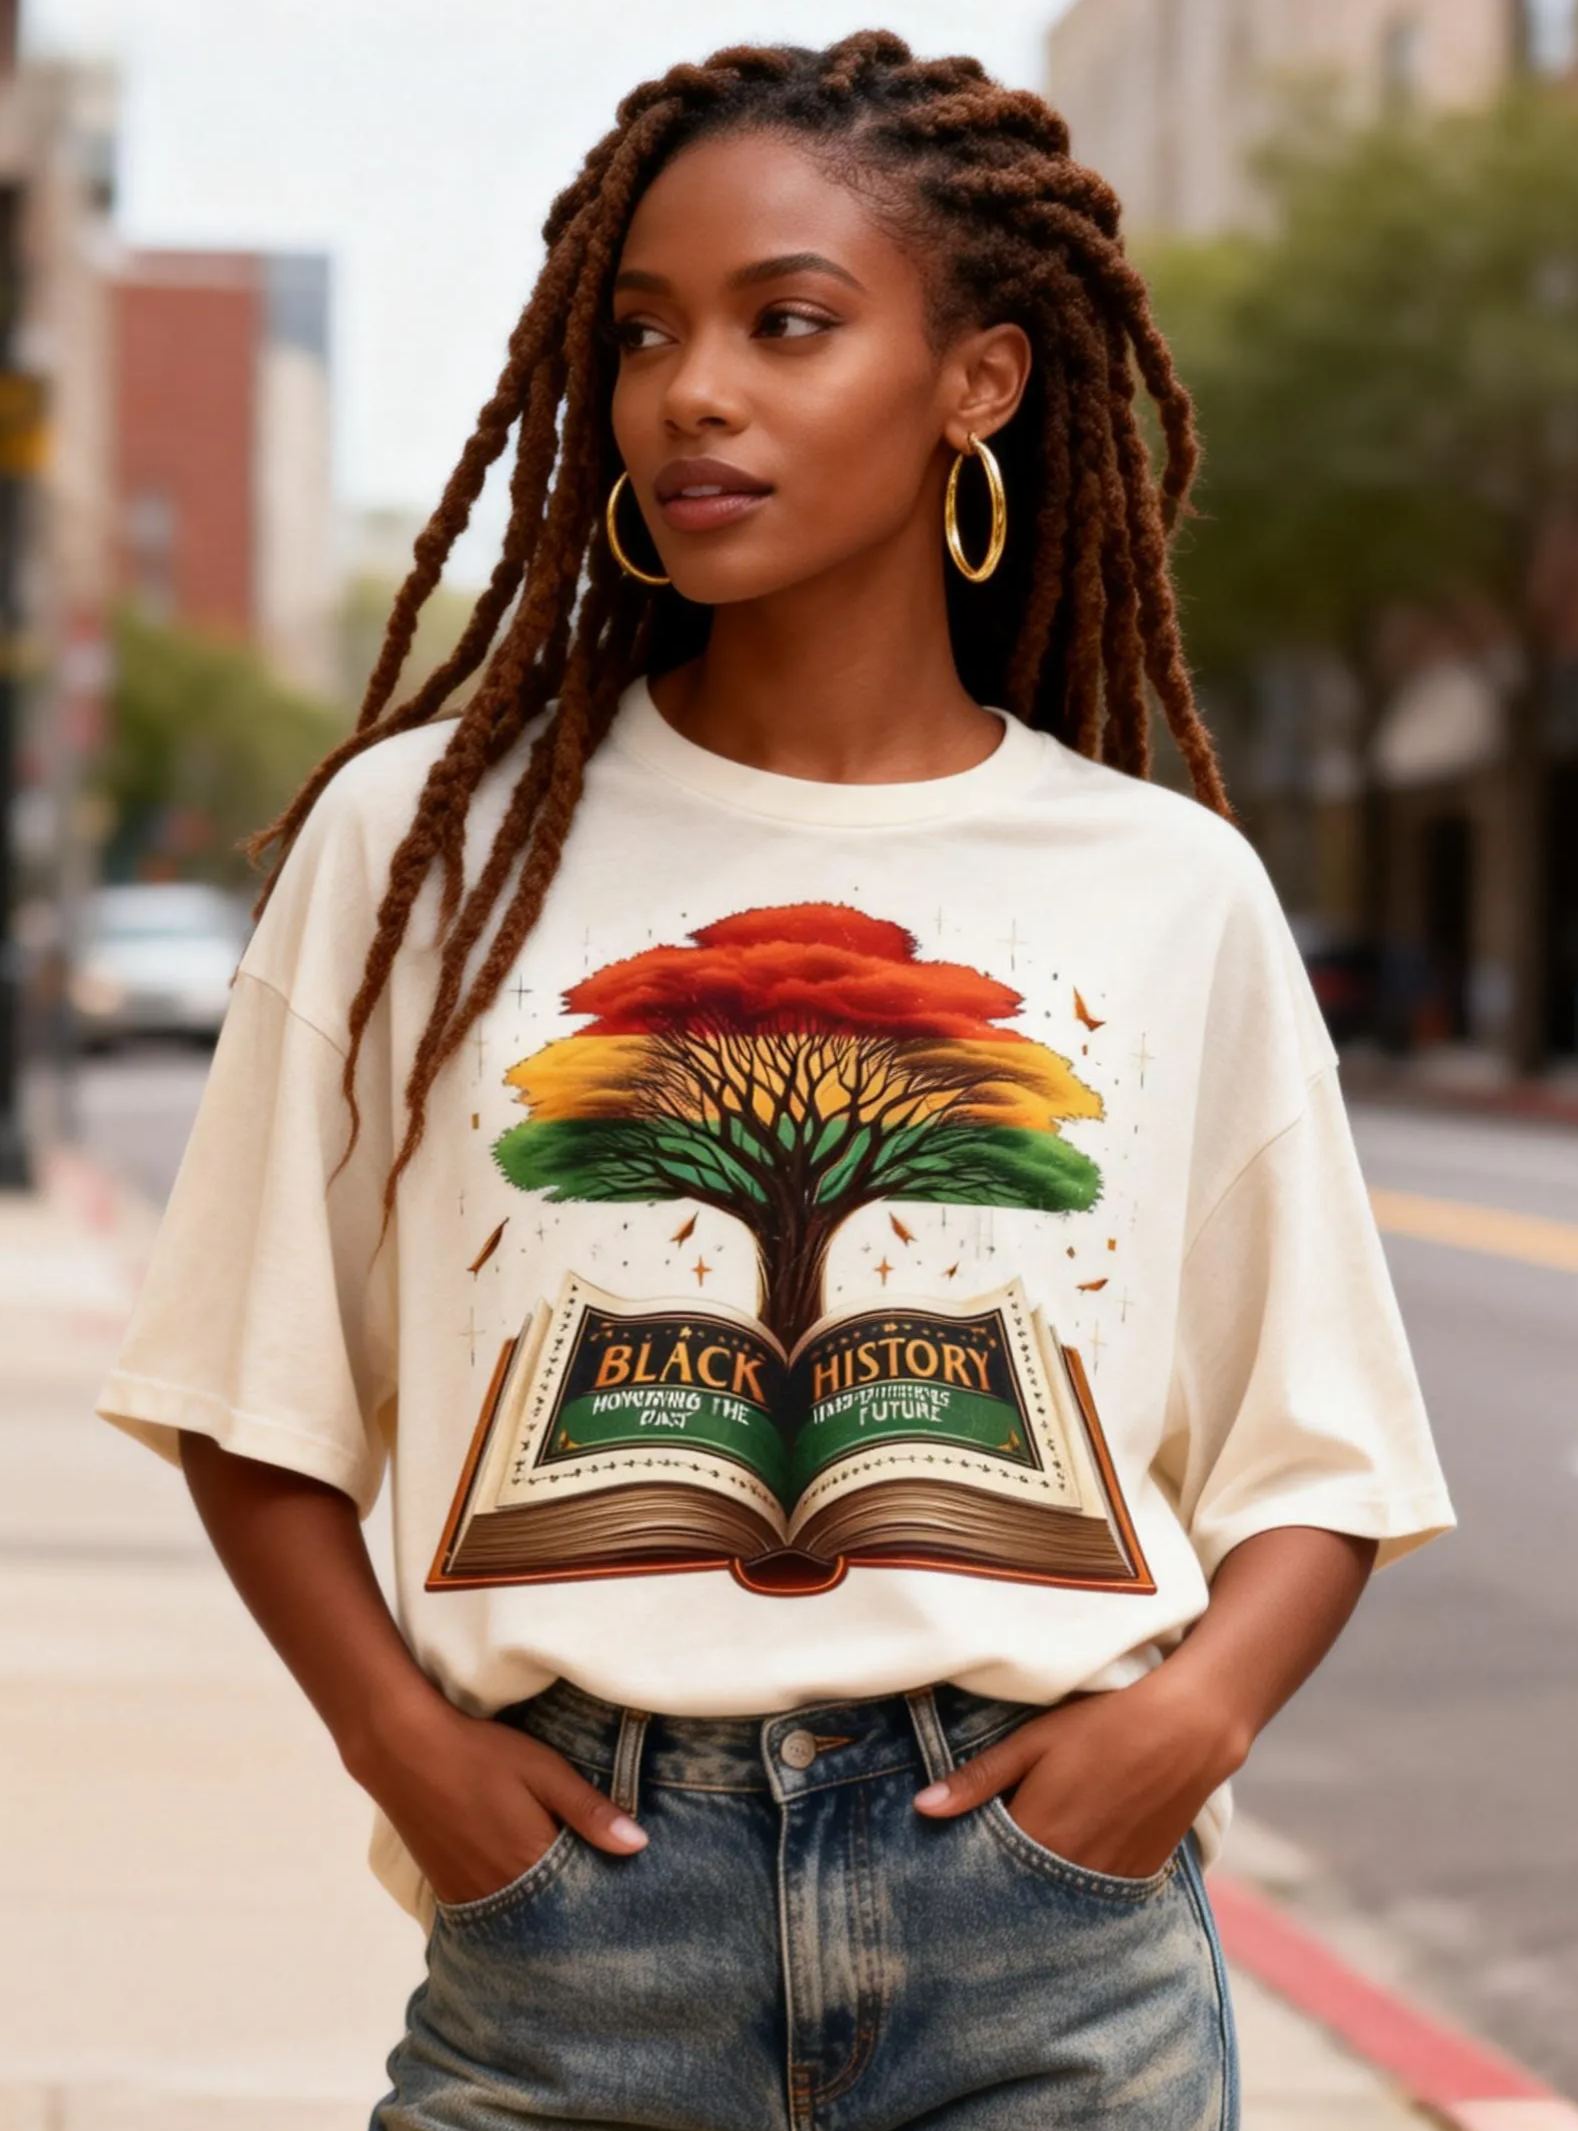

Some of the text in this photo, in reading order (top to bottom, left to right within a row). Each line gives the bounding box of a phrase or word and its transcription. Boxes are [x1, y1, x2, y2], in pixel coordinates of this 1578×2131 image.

[594, 1337, 992, 1404] BLACK HISTORY
[711, 1396, 750, 1426] THE
[859, 1400, 943, 1426] FUTURE
